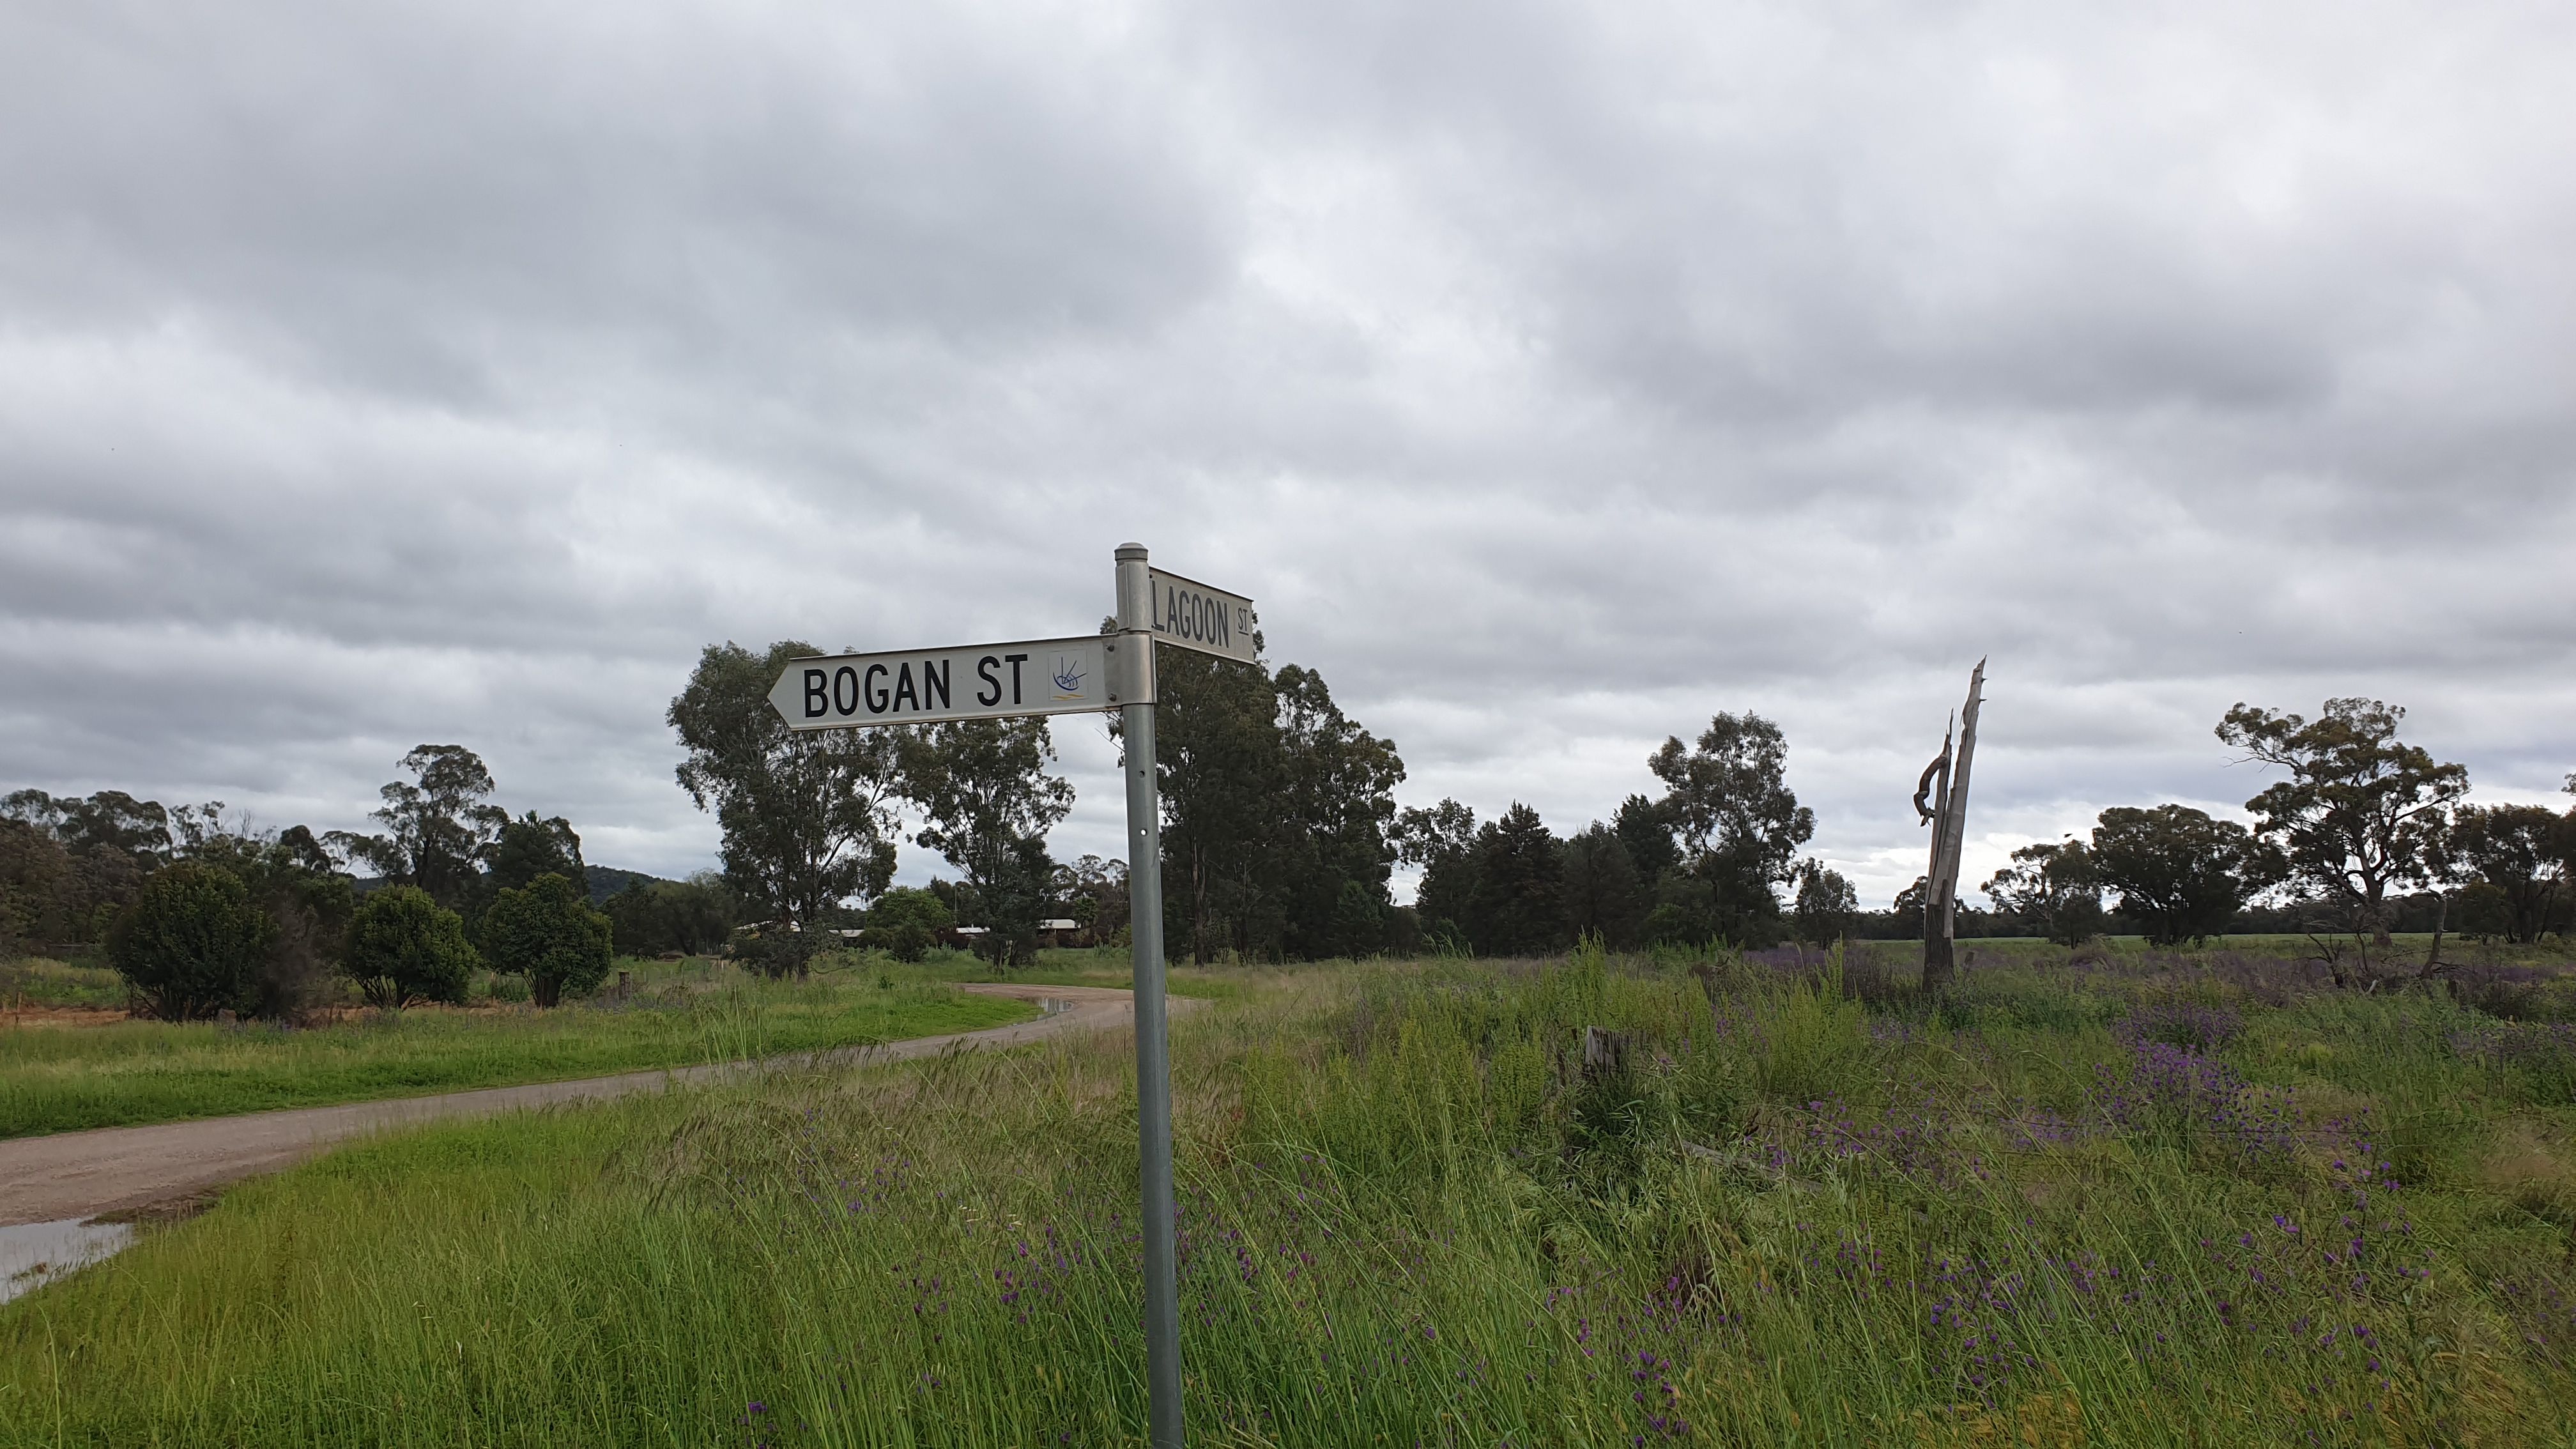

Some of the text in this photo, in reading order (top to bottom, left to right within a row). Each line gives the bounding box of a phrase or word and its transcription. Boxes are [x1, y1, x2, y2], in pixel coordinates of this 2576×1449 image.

[1151, 580, 1248, 648] LAGOON ST
[804, 654, 1028, 718] BOGAN ST
